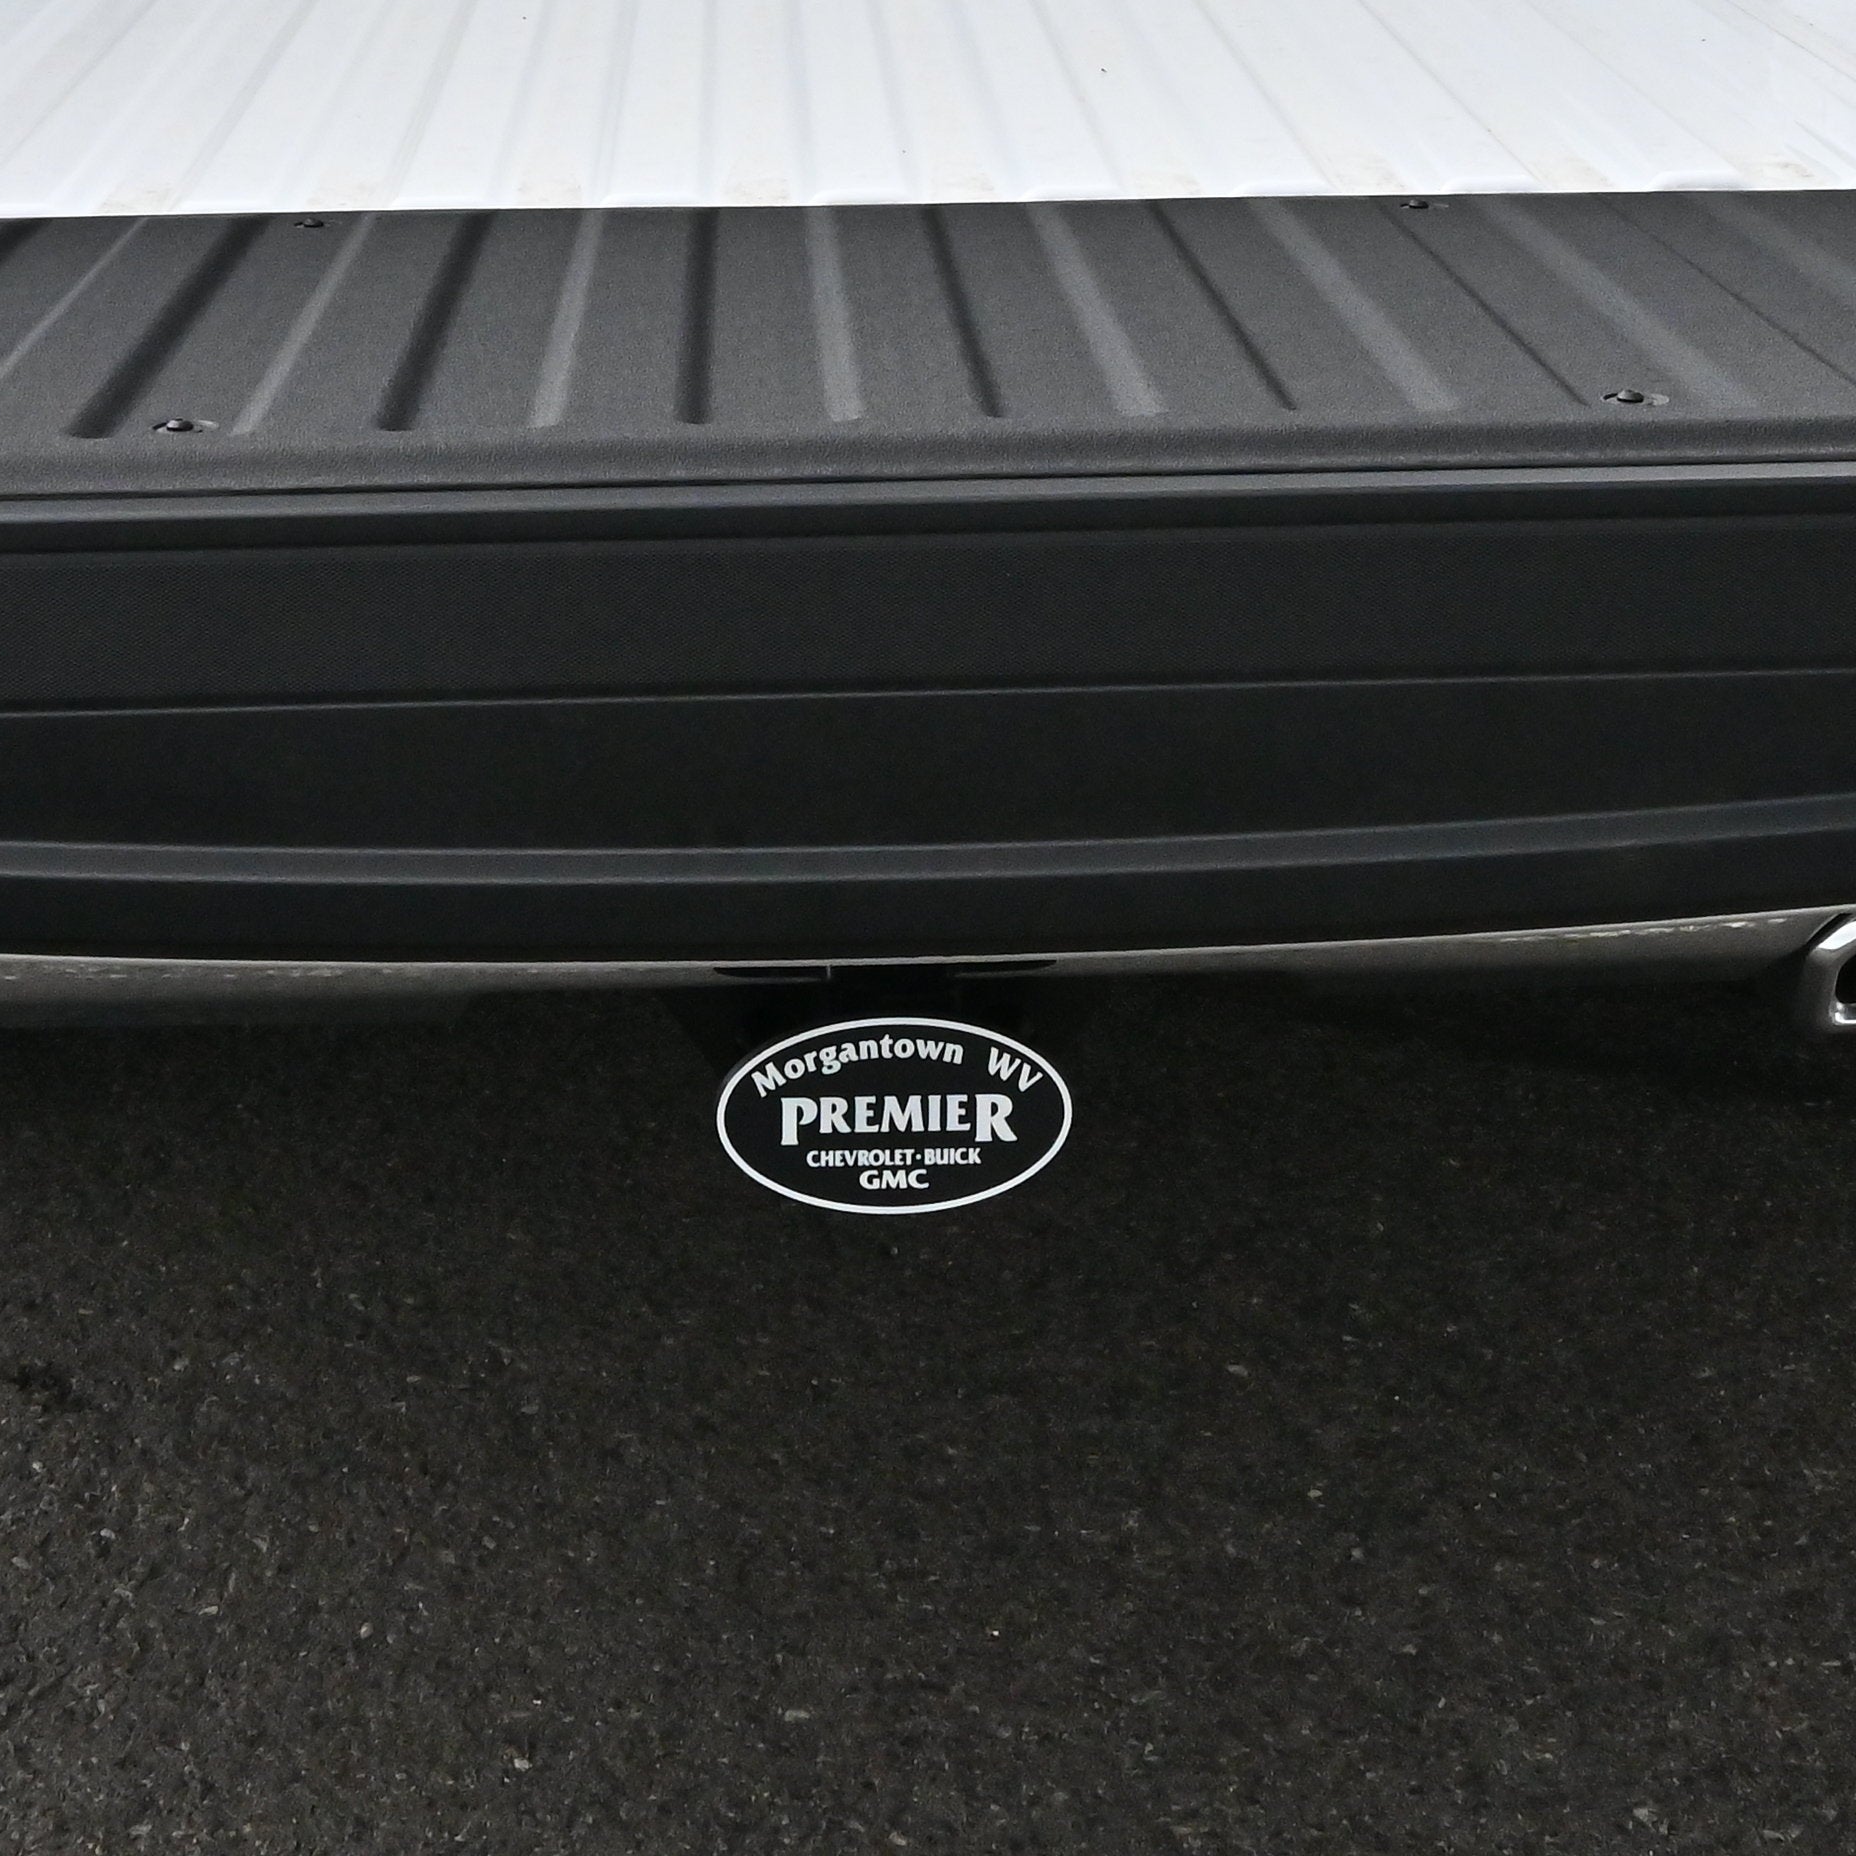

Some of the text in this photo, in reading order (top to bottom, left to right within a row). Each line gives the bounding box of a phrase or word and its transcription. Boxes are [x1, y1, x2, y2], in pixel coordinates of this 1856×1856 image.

[750, 1033, 1043, 1097] Morgantown WV
[780, 1093, 1018, 1146] PREMIER
[806, 1147, 982, 1167] CHEVROLET BUICK
[859, 1168, 930, 1190] GMC
